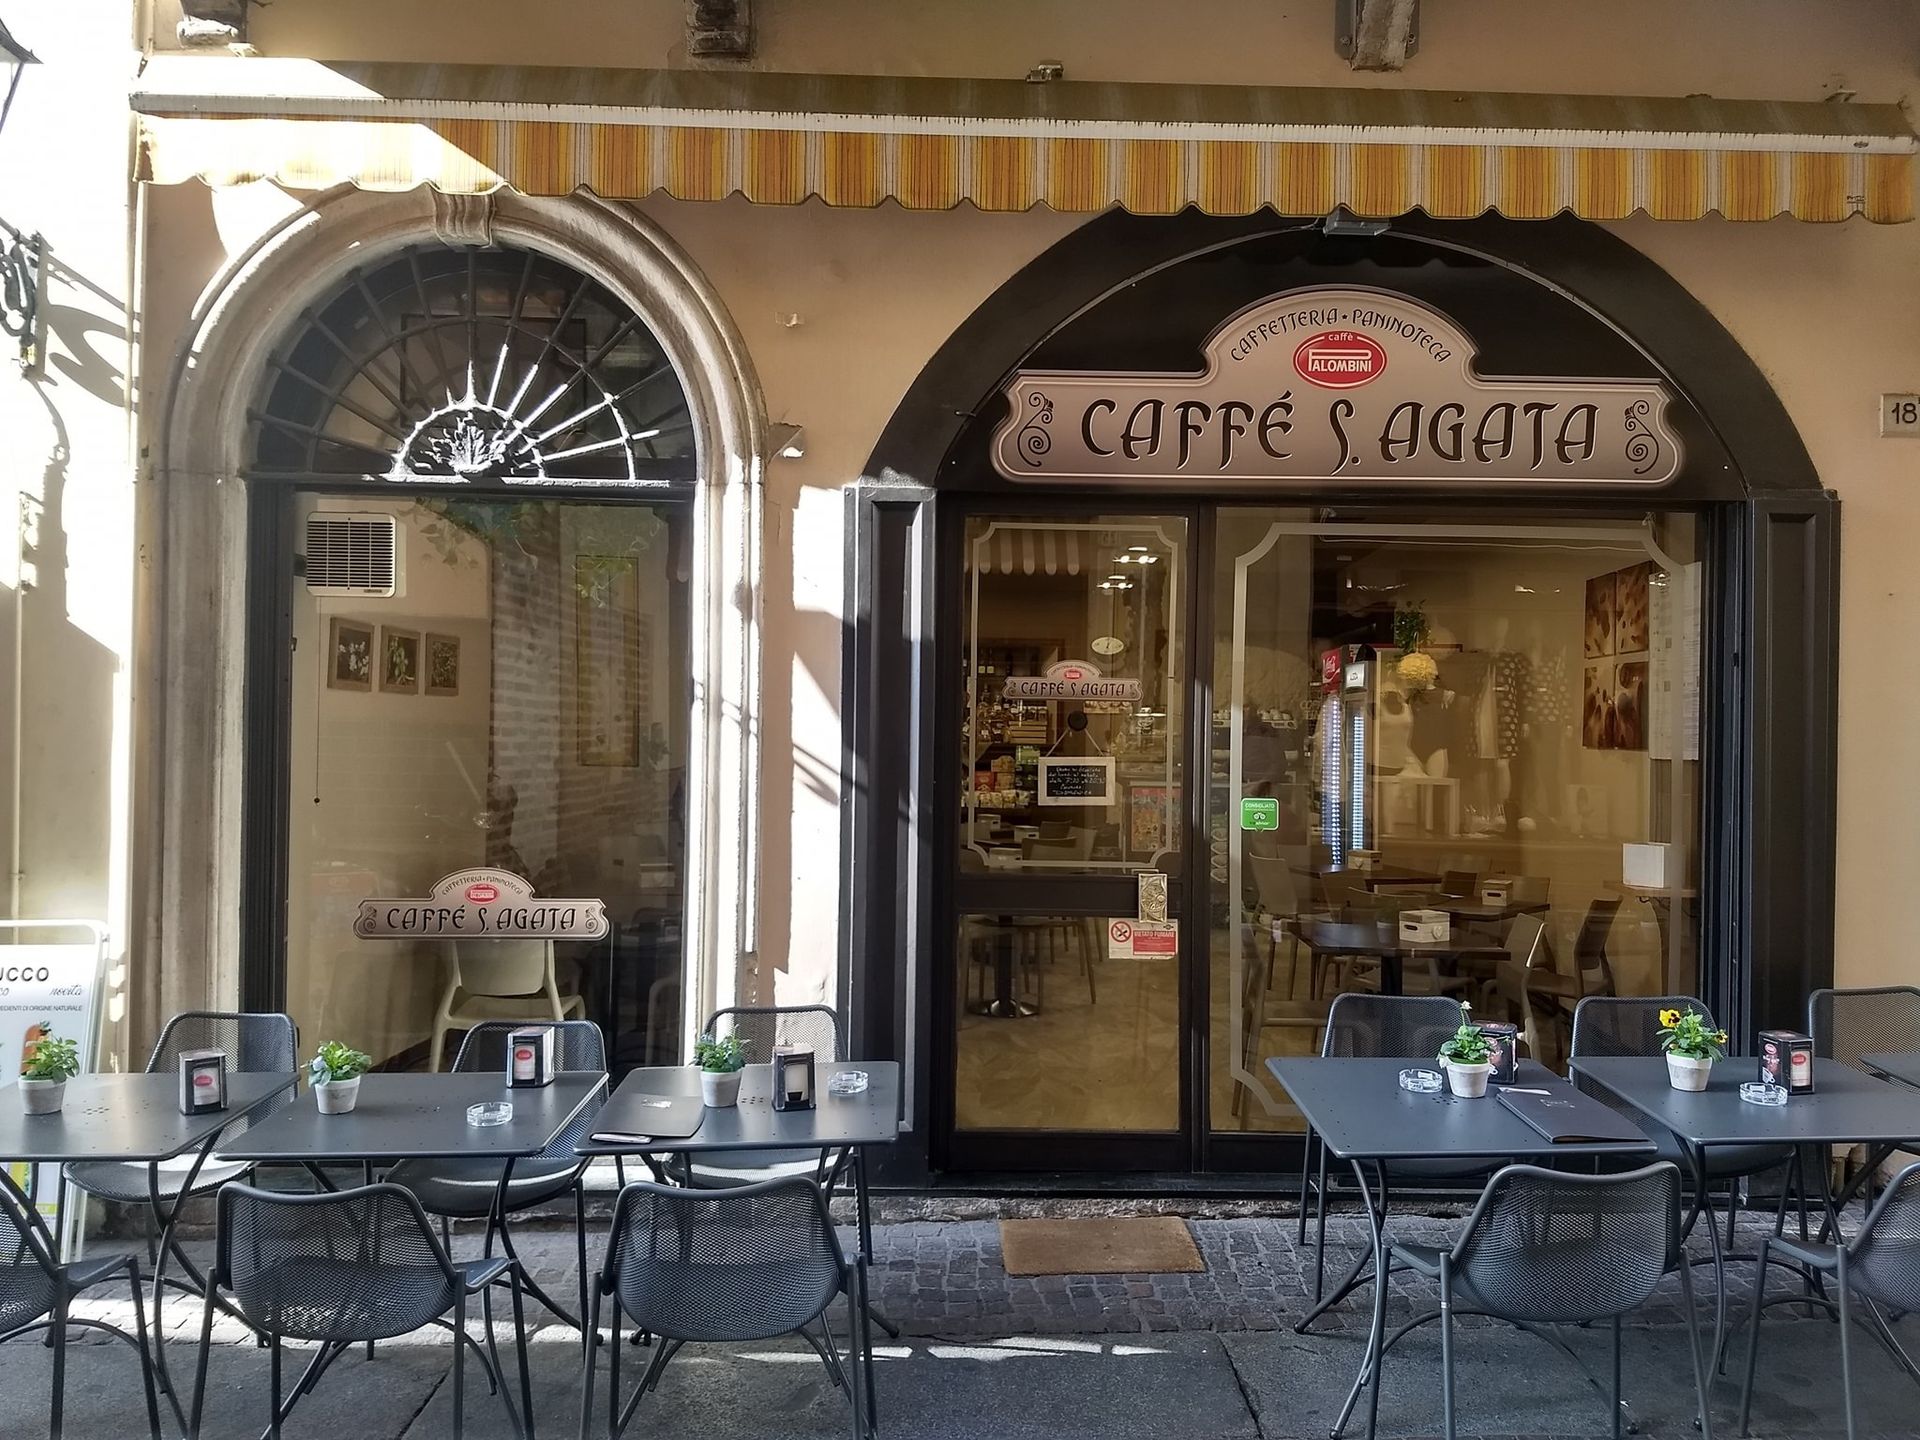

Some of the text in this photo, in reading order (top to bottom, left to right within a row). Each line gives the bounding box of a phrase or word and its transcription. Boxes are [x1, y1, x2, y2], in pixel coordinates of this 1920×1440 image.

[1230, 308, 1452, 363] CAFFETTERIA PANINOTECA
[1328, 332, 1354, 341] caffè
[1308, 348, 1372, 372] PALOMBINI
[1080, 389, 1600, 476] CAFFÉ S. AGATA
[1021, 680, 1064, 695] CAFFÉ
[1081, 683, 1125, 696] AGATA
[387, 904, 576, 933] CAFFÉ S. AGATA
